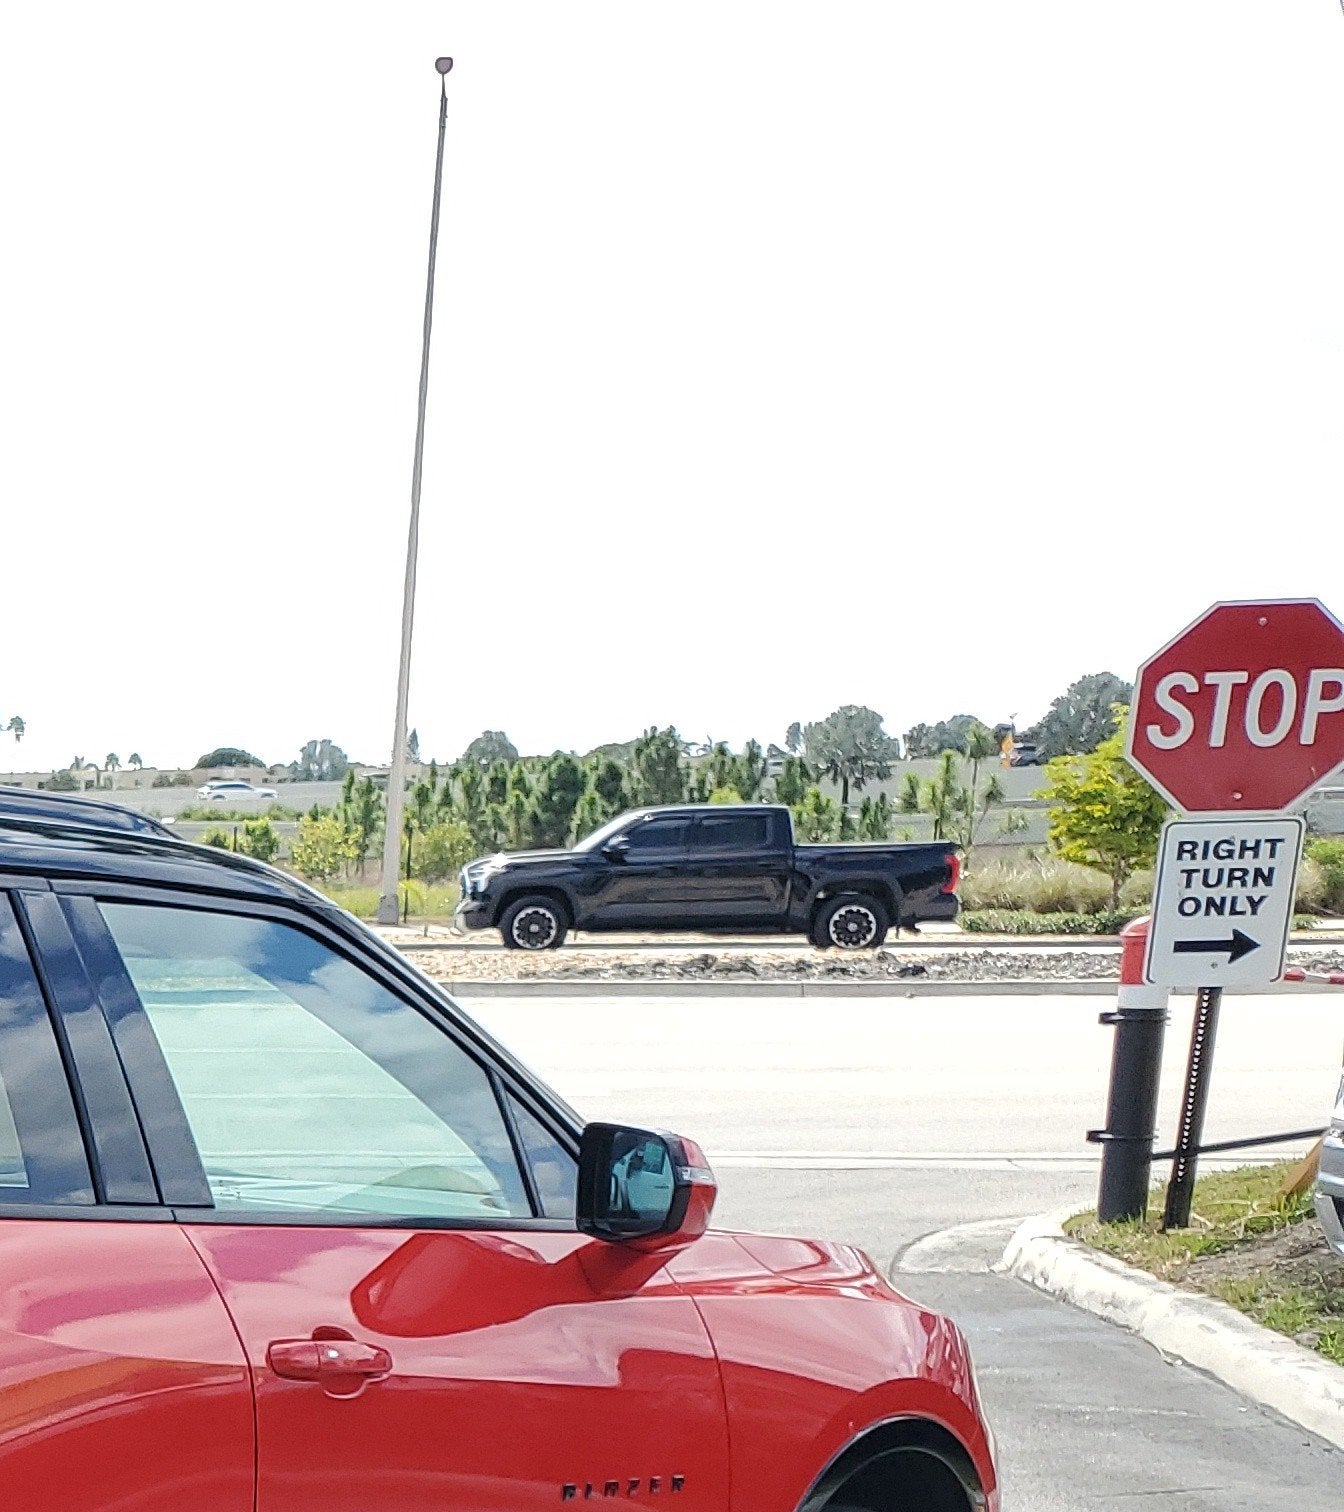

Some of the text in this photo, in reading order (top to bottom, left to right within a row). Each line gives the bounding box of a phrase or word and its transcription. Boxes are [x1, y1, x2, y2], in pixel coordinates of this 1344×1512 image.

[1146, 668, 1344, 750] STOP
[1176, 838, 1286, 862] RIGHT
[1179, 866, 1276, 889] TURN
[1177, 895, 1269, 917] ONLY
[562, 1474, 685, 1500] BLAZER
